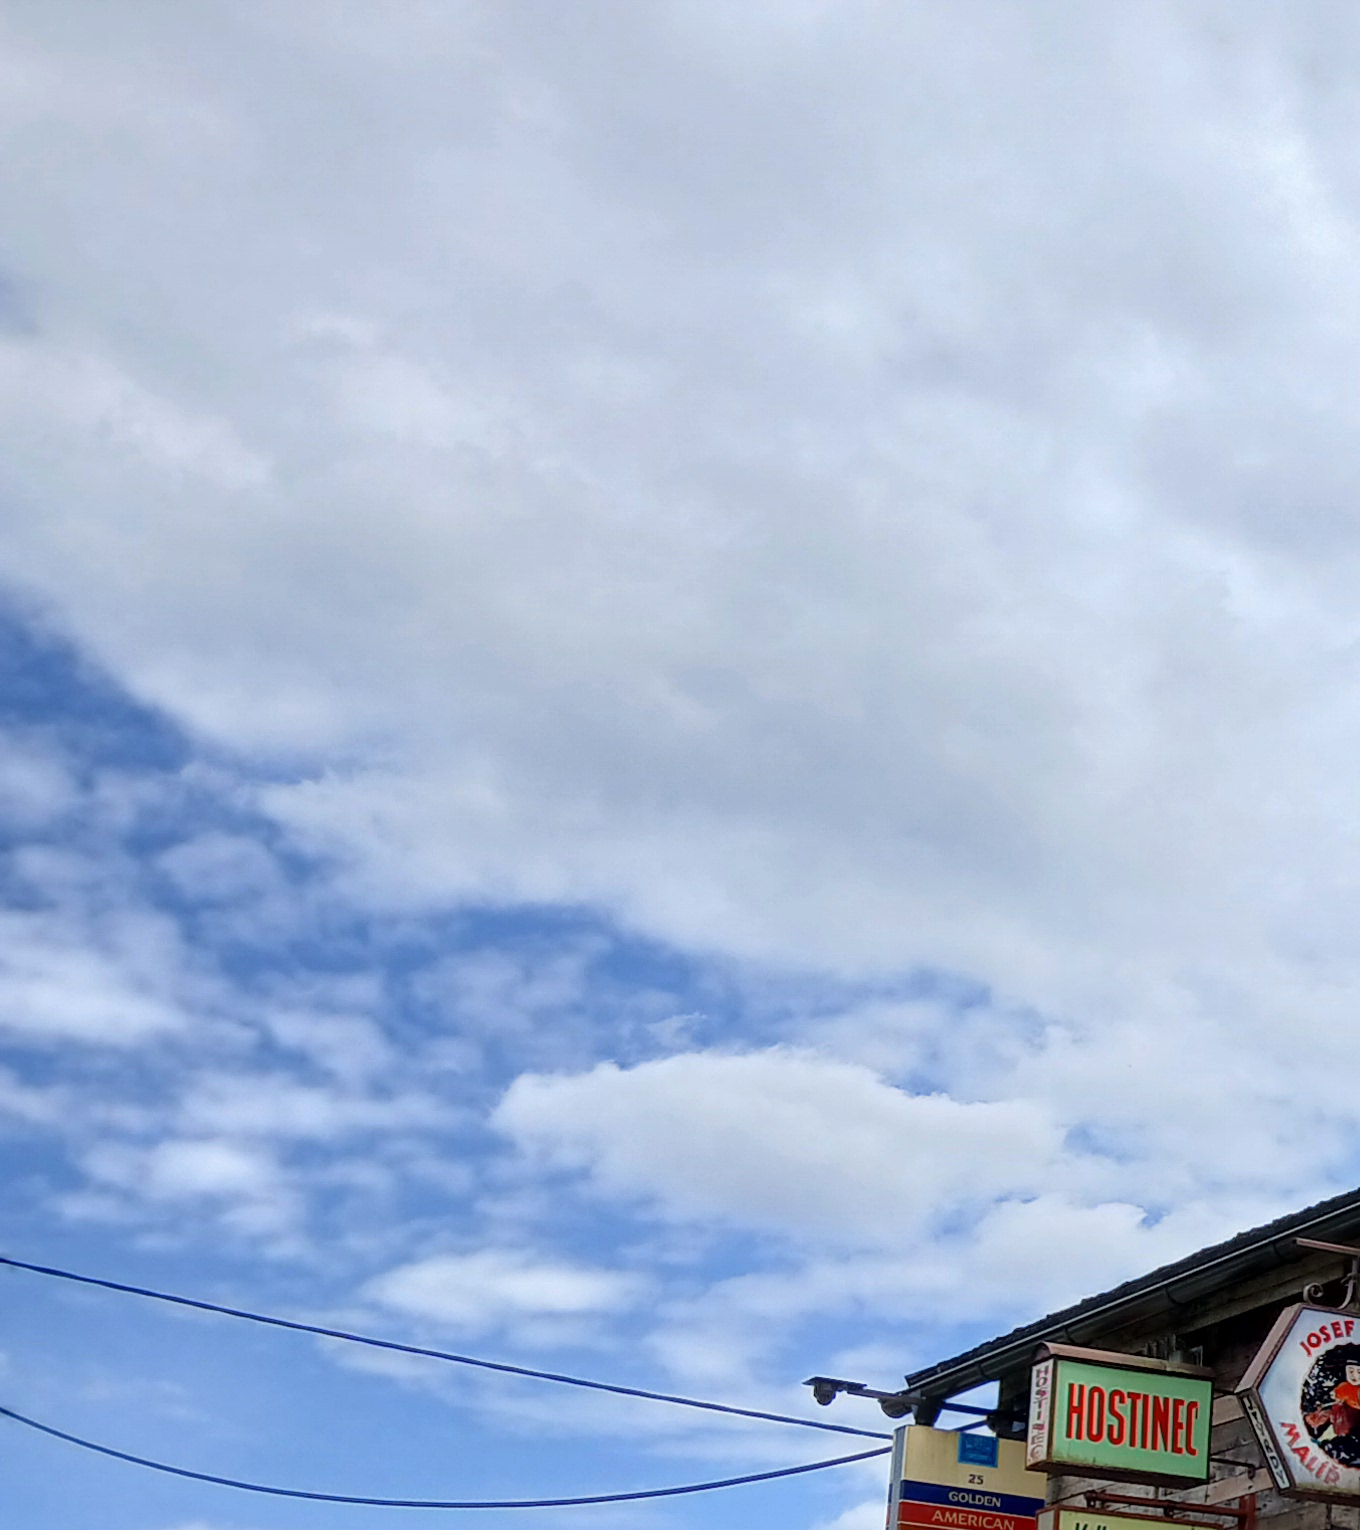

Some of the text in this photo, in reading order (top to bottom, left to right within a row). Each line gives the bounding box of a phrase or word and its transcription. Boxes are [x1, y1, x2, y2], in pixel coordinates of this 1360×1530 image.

[1299, 1320, 1354, 1357] JOSEF
[1065, 1382, 1199, 1457] HOSTINEC
[1279, 1421, 1341, 1485] MALÍŘ
[968, 1474, 984, 1485] 25
[948, 1491, 1002, 1508] GOLDEN
